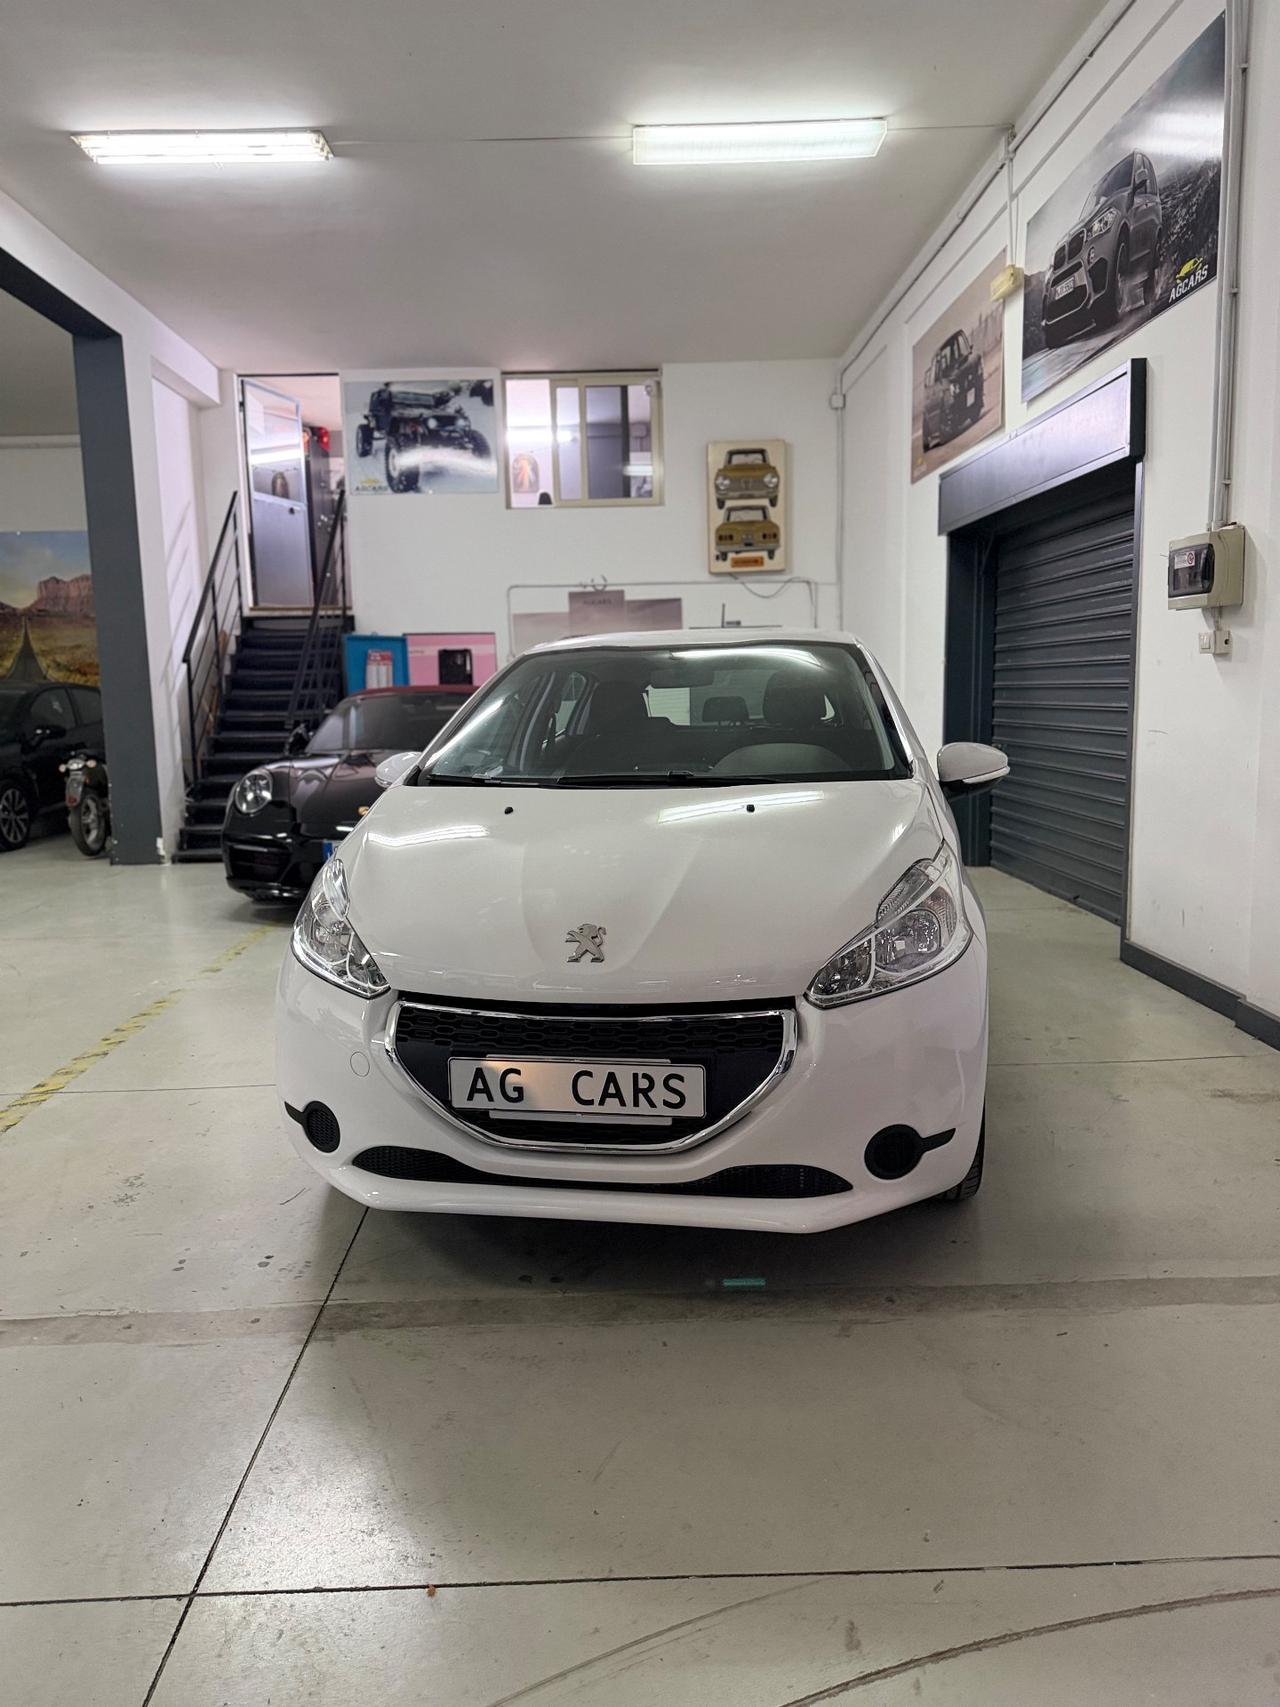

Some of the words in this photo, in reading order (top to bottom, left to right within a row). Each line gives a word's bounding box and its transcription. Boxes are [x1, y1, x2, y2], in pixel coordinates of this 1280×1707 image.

[1169, 264, 1208, 303] AGCARS
[466, 1067, 525, 1104] AG
[571, 1069, 687, 1110] CARS
